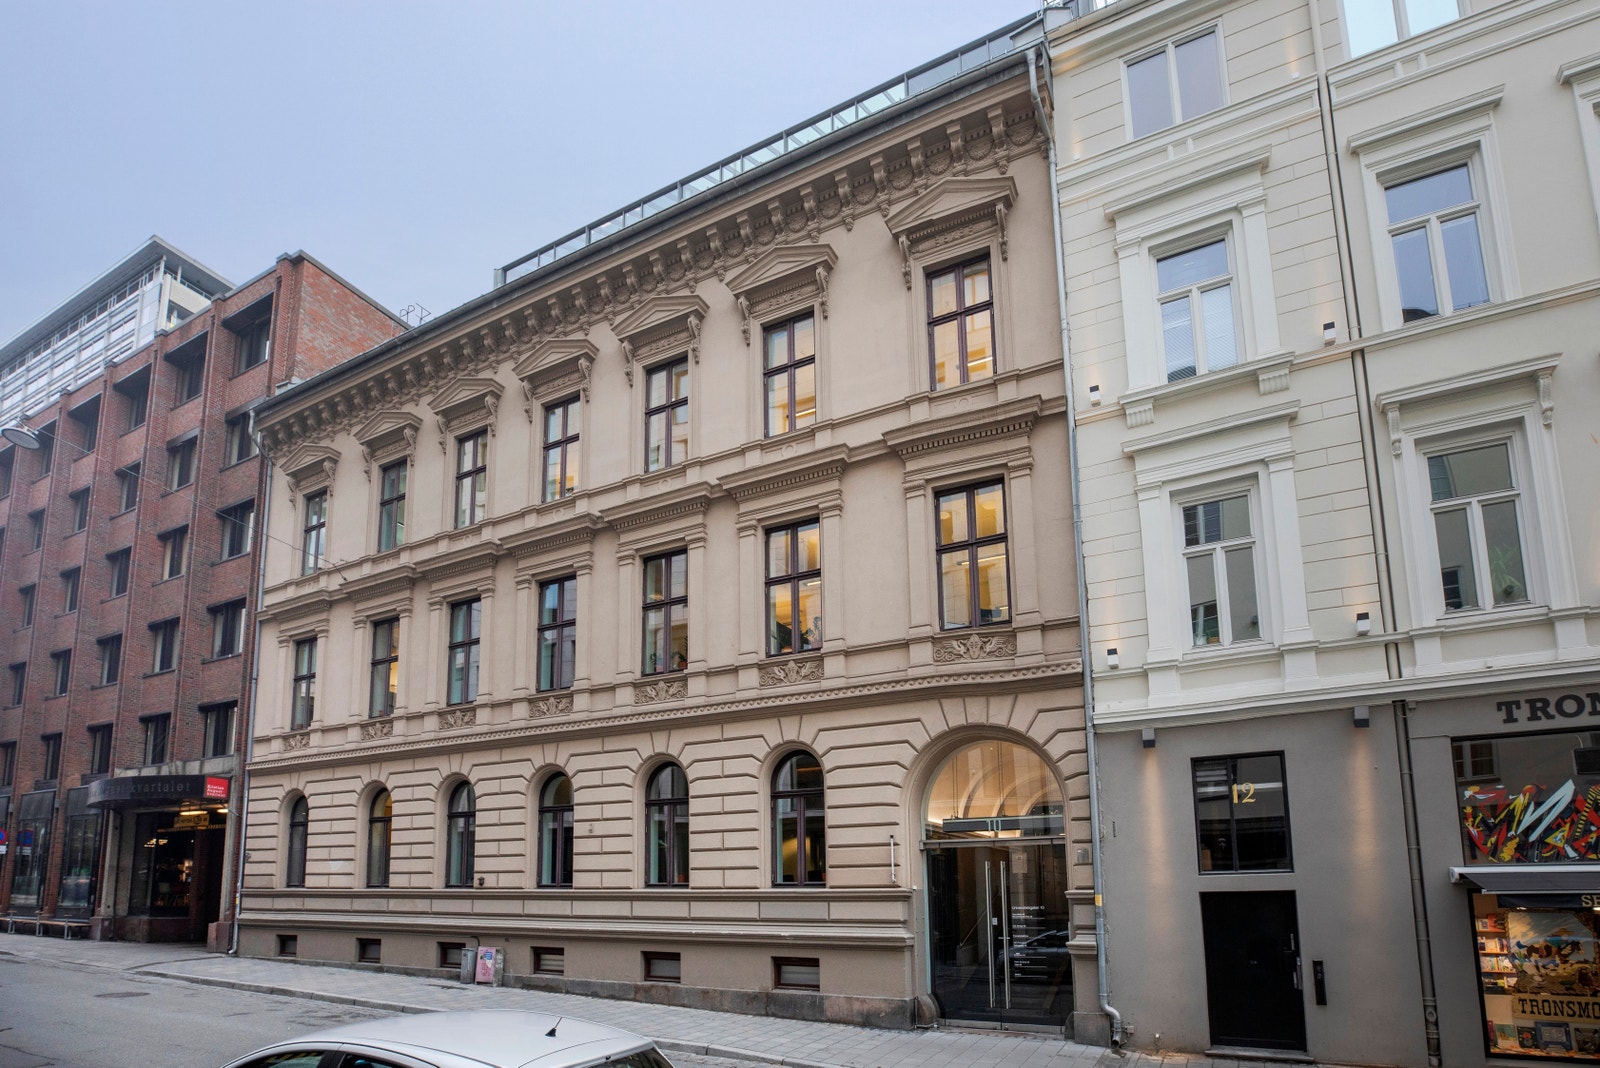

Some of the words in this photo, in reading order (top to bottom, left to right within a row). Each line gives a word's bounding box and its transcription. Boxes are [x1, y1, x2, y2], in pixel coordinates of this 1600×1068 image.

[1232, 782, 1256, 804] 12
[986, 818, 1002, 832] 10
[1518, 998, 1600, 1020] TRONSMO
